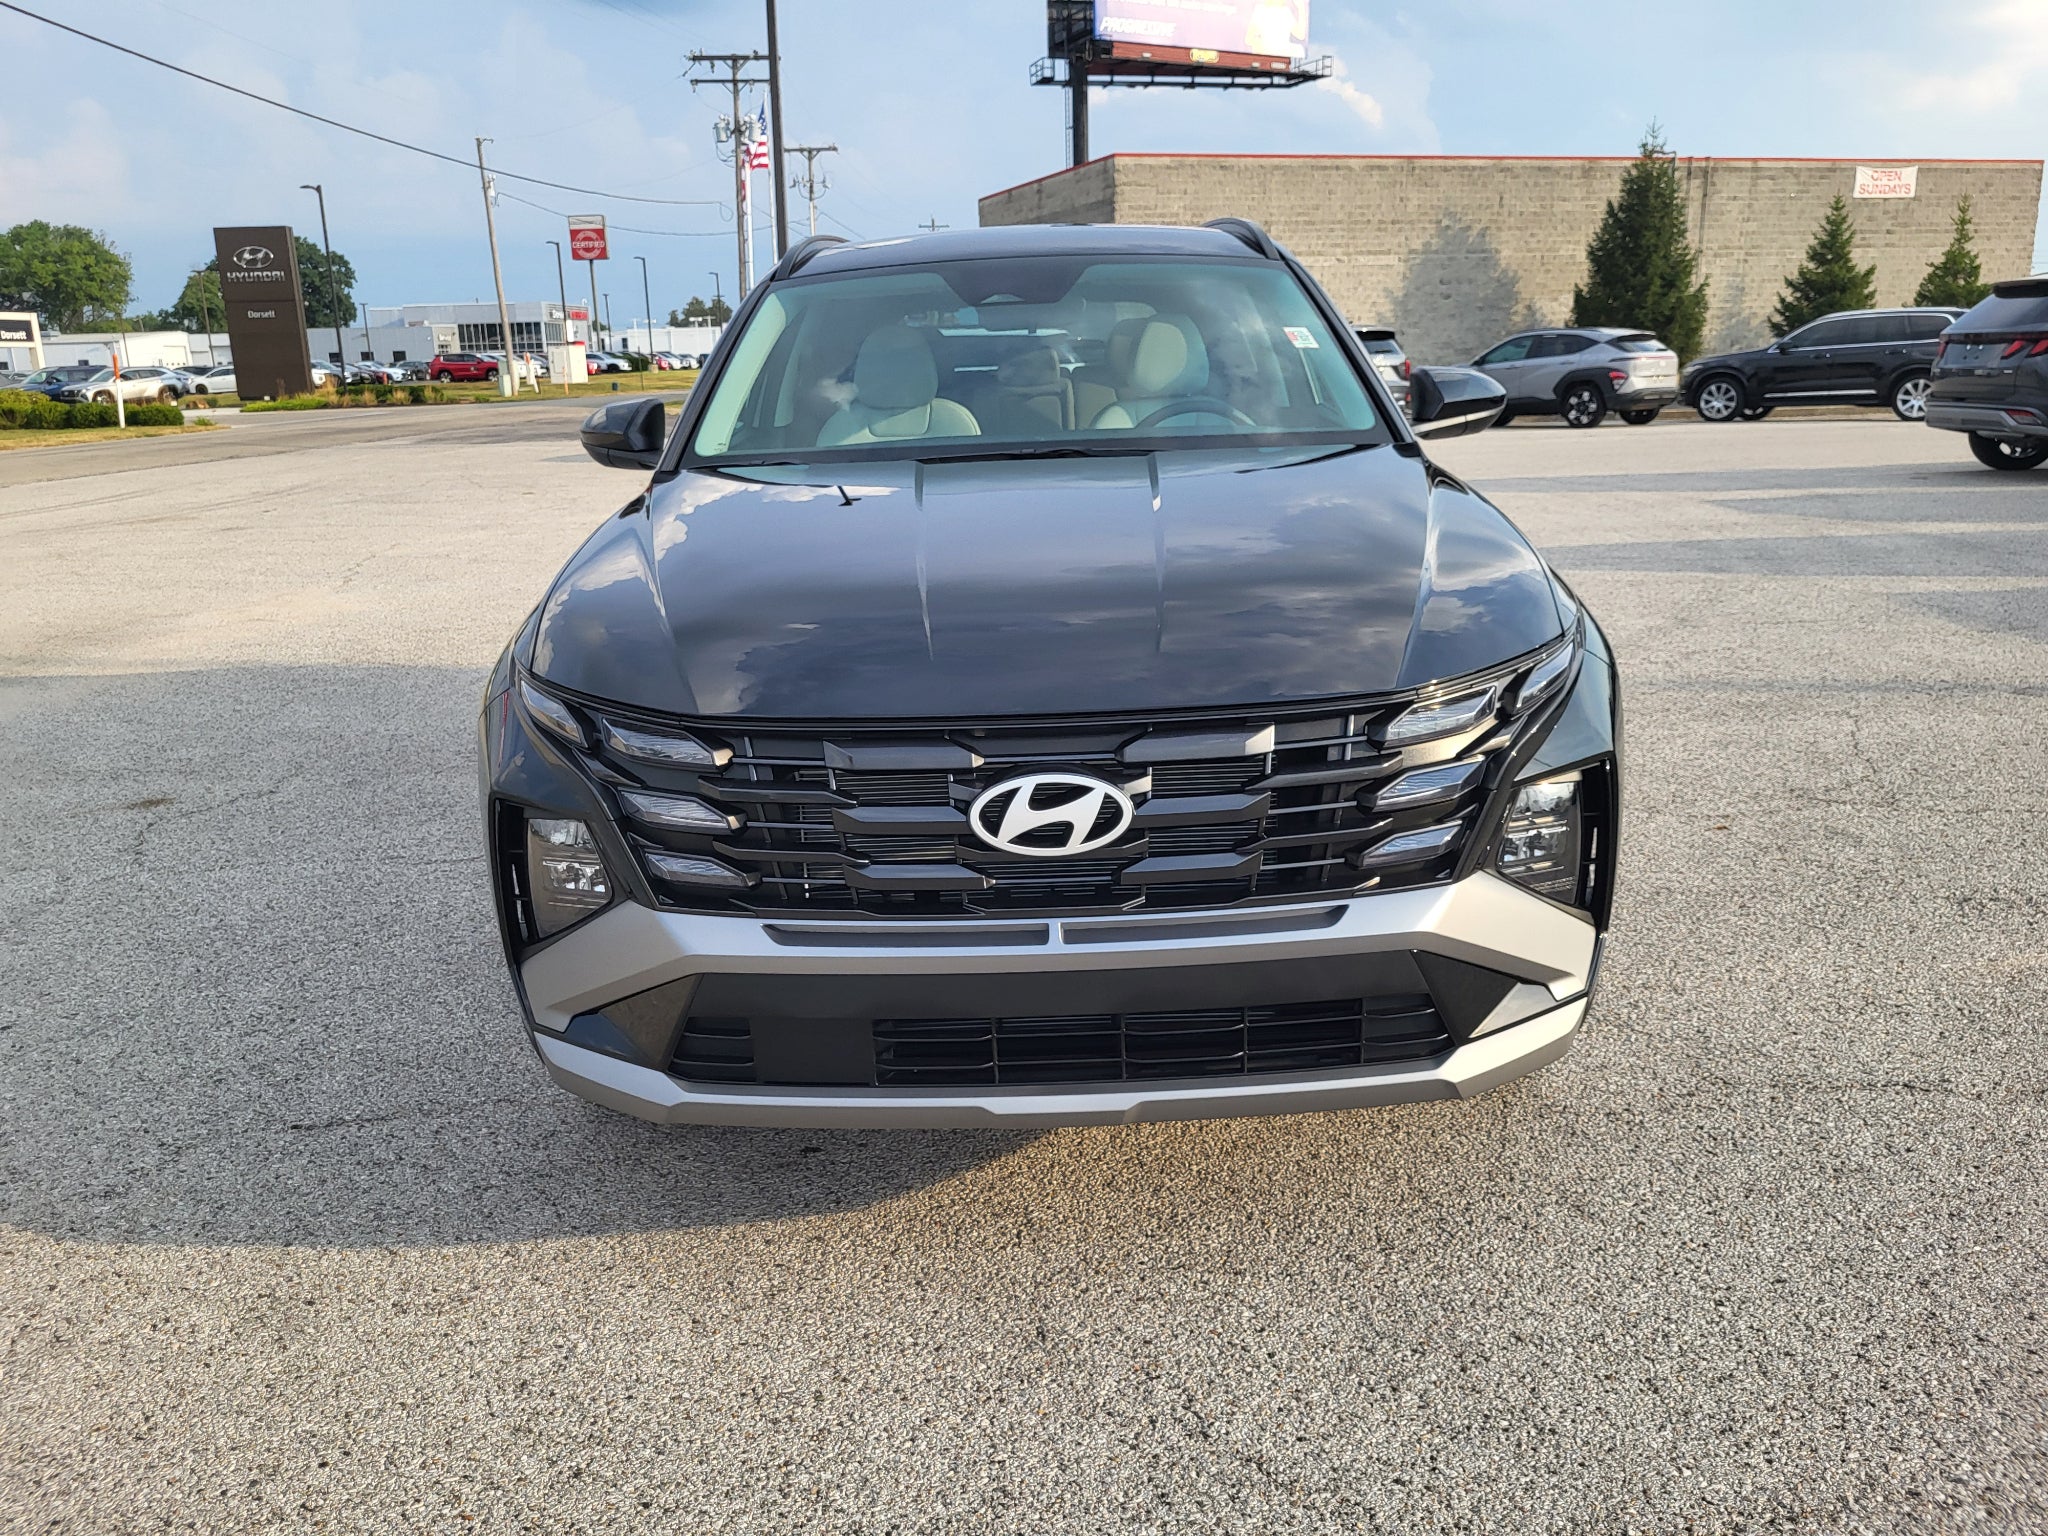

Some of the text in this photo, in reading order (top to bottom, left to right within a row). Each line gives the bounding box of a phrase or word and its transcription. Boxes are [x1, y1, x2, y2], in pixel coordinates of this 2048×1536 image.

[1871, 169, 1903, 182] OPEN
[1858, 183, 1912, 195] SUNDAYS
[572, 240, 606, 249] CERTIFIED
[226, 271, 285, 282] HYUNDAI
[247, 310, 276, 319] Dorsett
[0, 330, 27, 340] Dorsett
